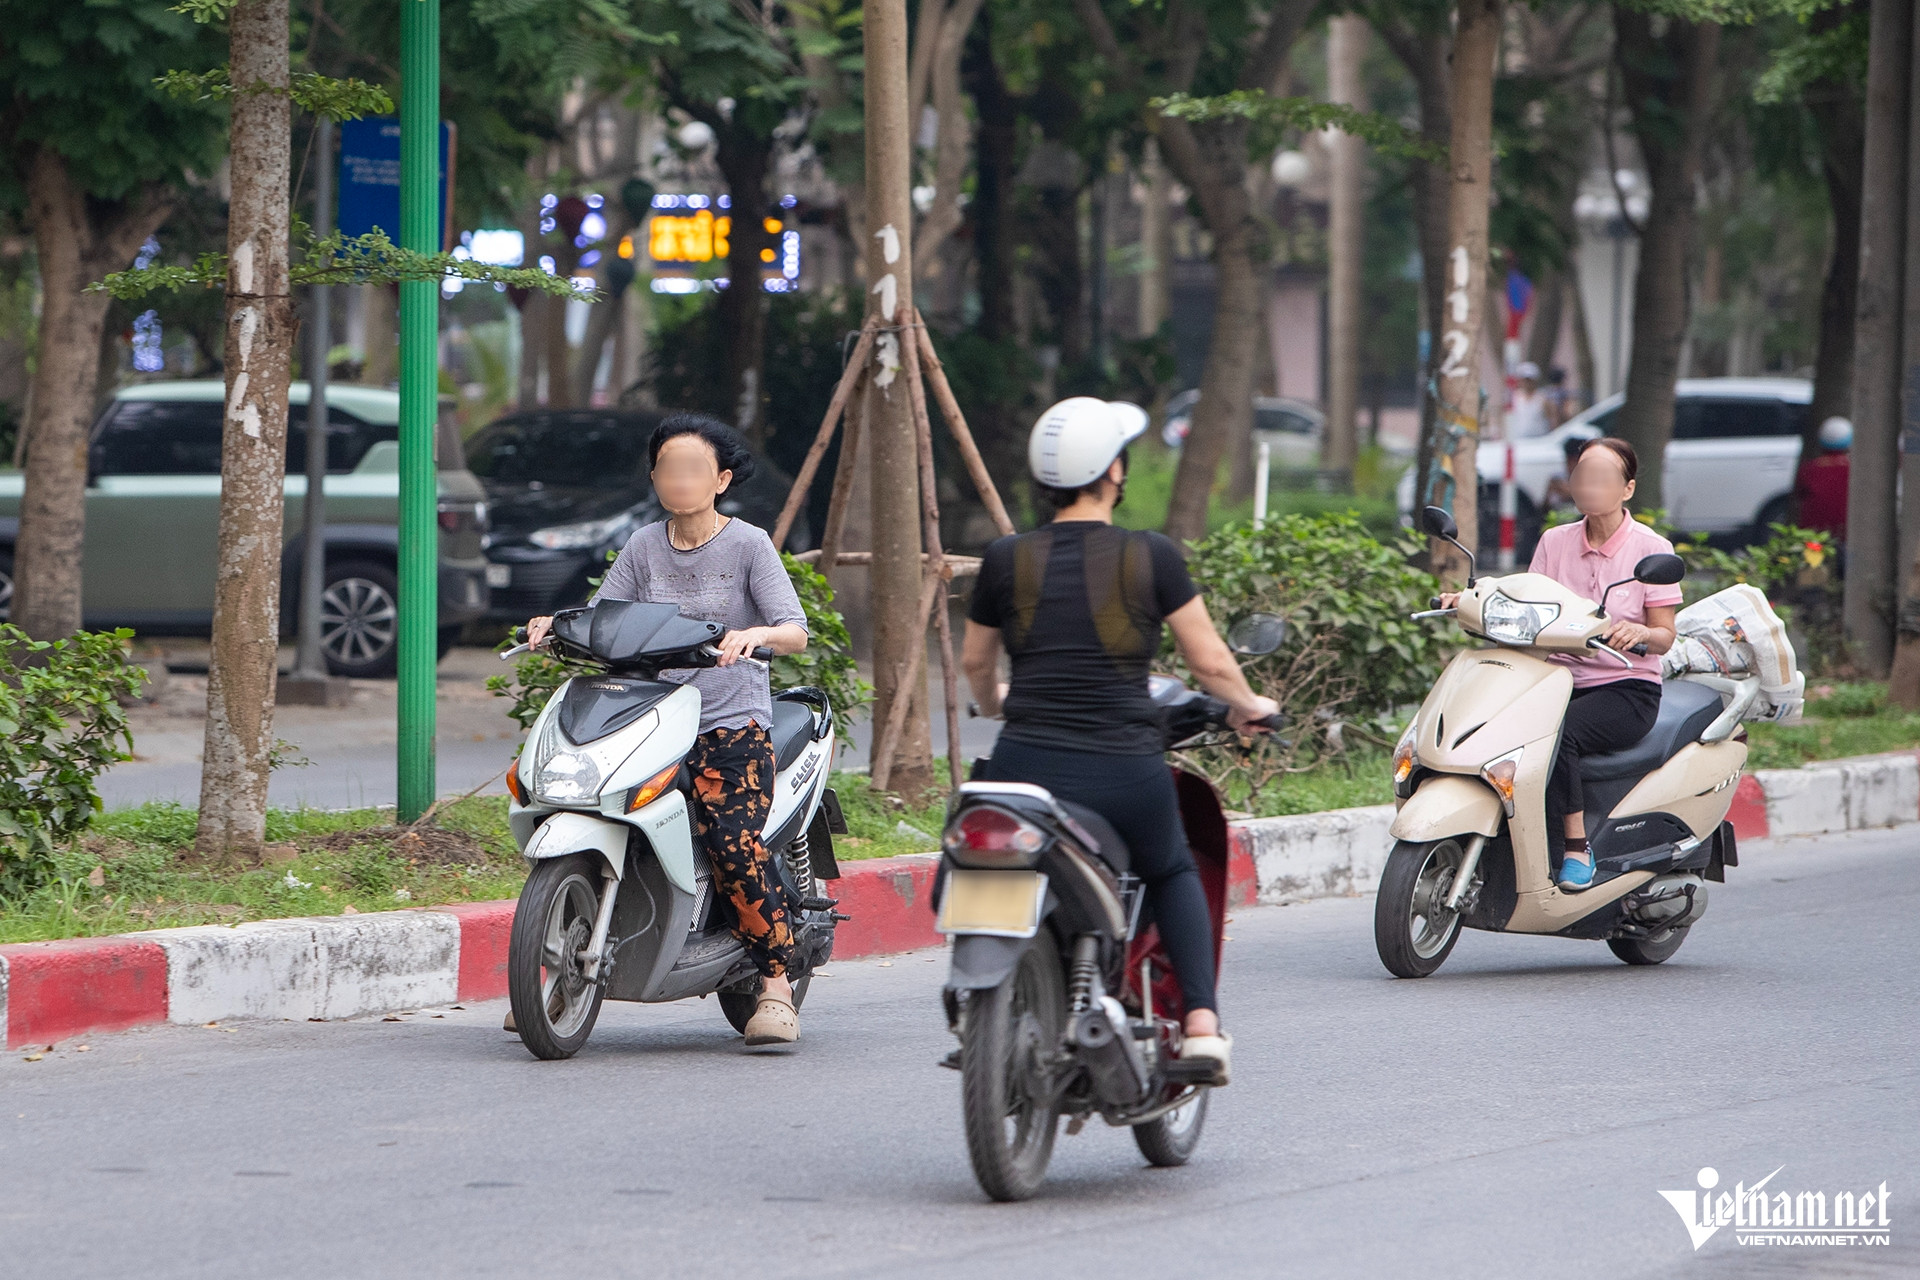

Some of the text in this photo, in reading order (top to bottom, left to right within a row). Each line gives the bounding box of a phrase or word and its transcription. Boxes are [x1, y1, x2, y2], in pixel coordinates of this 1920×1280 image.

[871, 223, 901, 390] 113
[1440, 245, 1470, 378] 112
[790, 751, 817, 789] CLICK
[655, 808, 685, 830] HONDA
